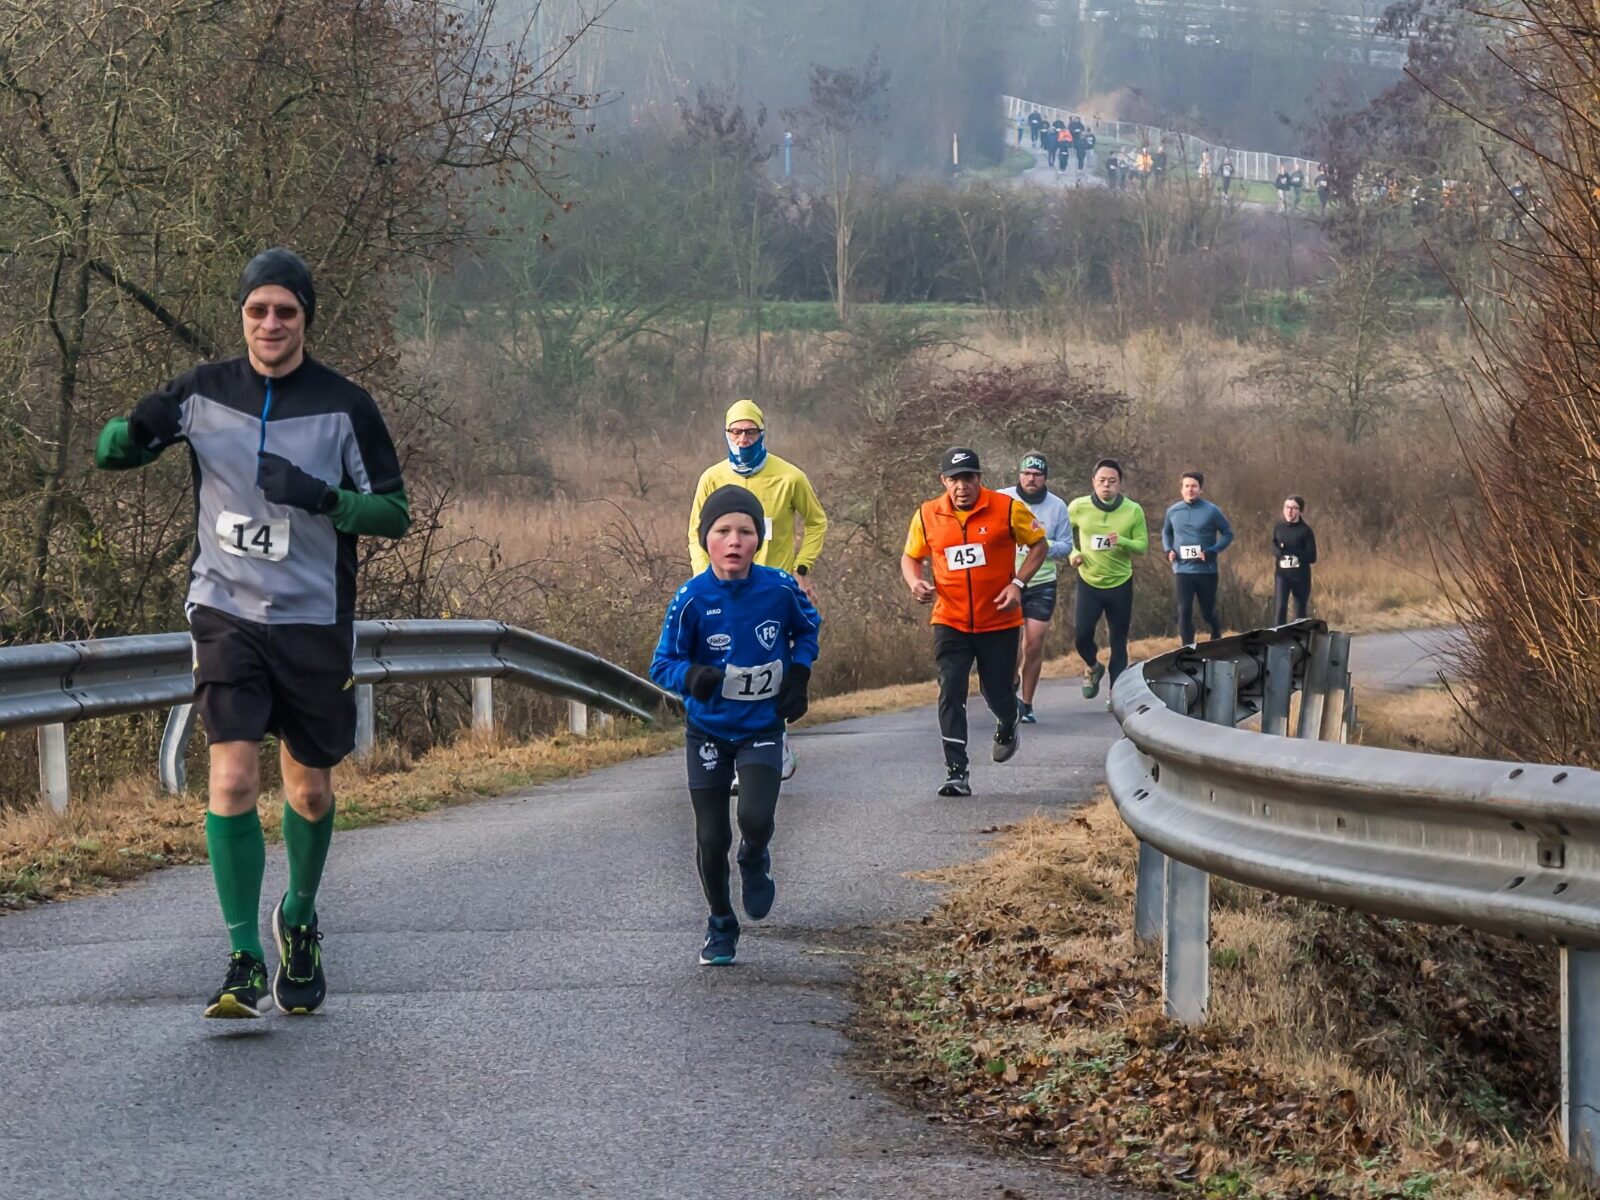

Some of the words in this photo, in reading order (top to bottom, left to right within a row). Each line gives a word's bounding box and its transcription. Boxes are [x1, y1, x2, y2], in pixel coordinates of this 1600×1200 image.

[231, 523, 274, 555] 14
[1096, 537, 1112, 549] 74
[953, 547, 977, 566] 45
[762, 626, 776, 641] FC
[738, 669, 773, 696] 12
